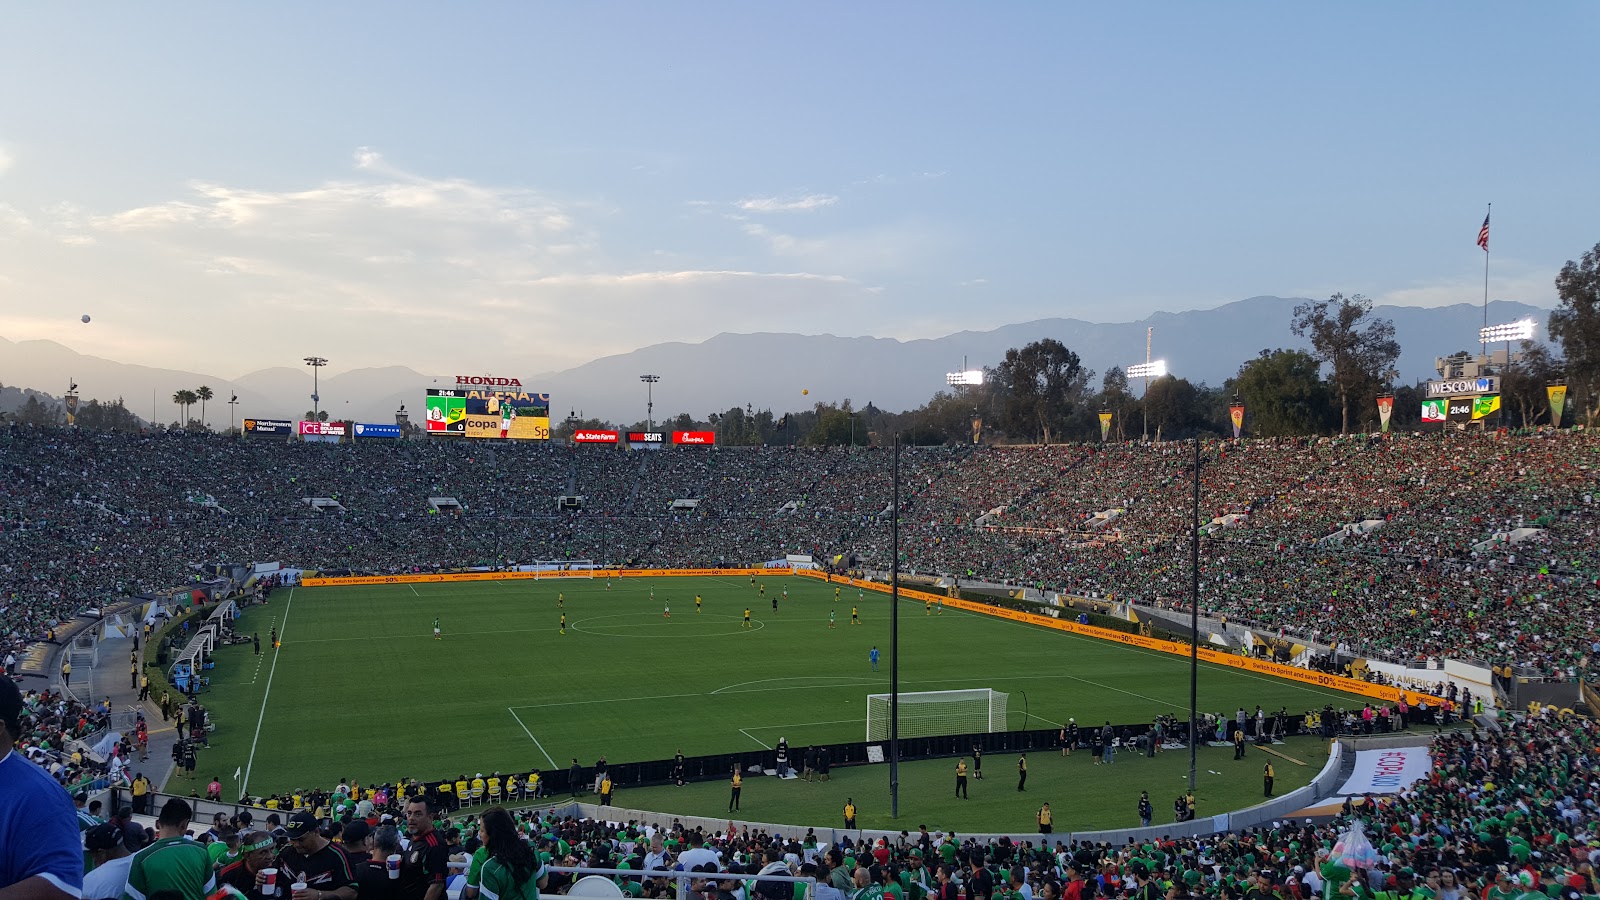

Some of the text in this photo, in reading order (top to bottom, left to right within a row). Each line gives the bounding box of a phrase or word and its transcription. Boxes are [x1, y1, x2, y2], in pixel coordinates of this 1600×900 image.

[456, 376, 522, 387] HONDA
[1431, 381, 1476, 393] WESCOM
[1450, 405, 1469, 414] 21:46
[302, 424, 320, 434] ICE
[534, 425, 549, 439] Sp
[1121, 635, 1133, 644] 50%
[1227, 657, 1240, 666] Sprint
[1253, 662, 1270, 671] Switch
[1276, 666, 1293, 676] Sprint
[1318, 675, 1336, 687] 50%
[1397, 675, 1437, 689] AMERICA
[1380, 690, 1396, 700] Sprint
